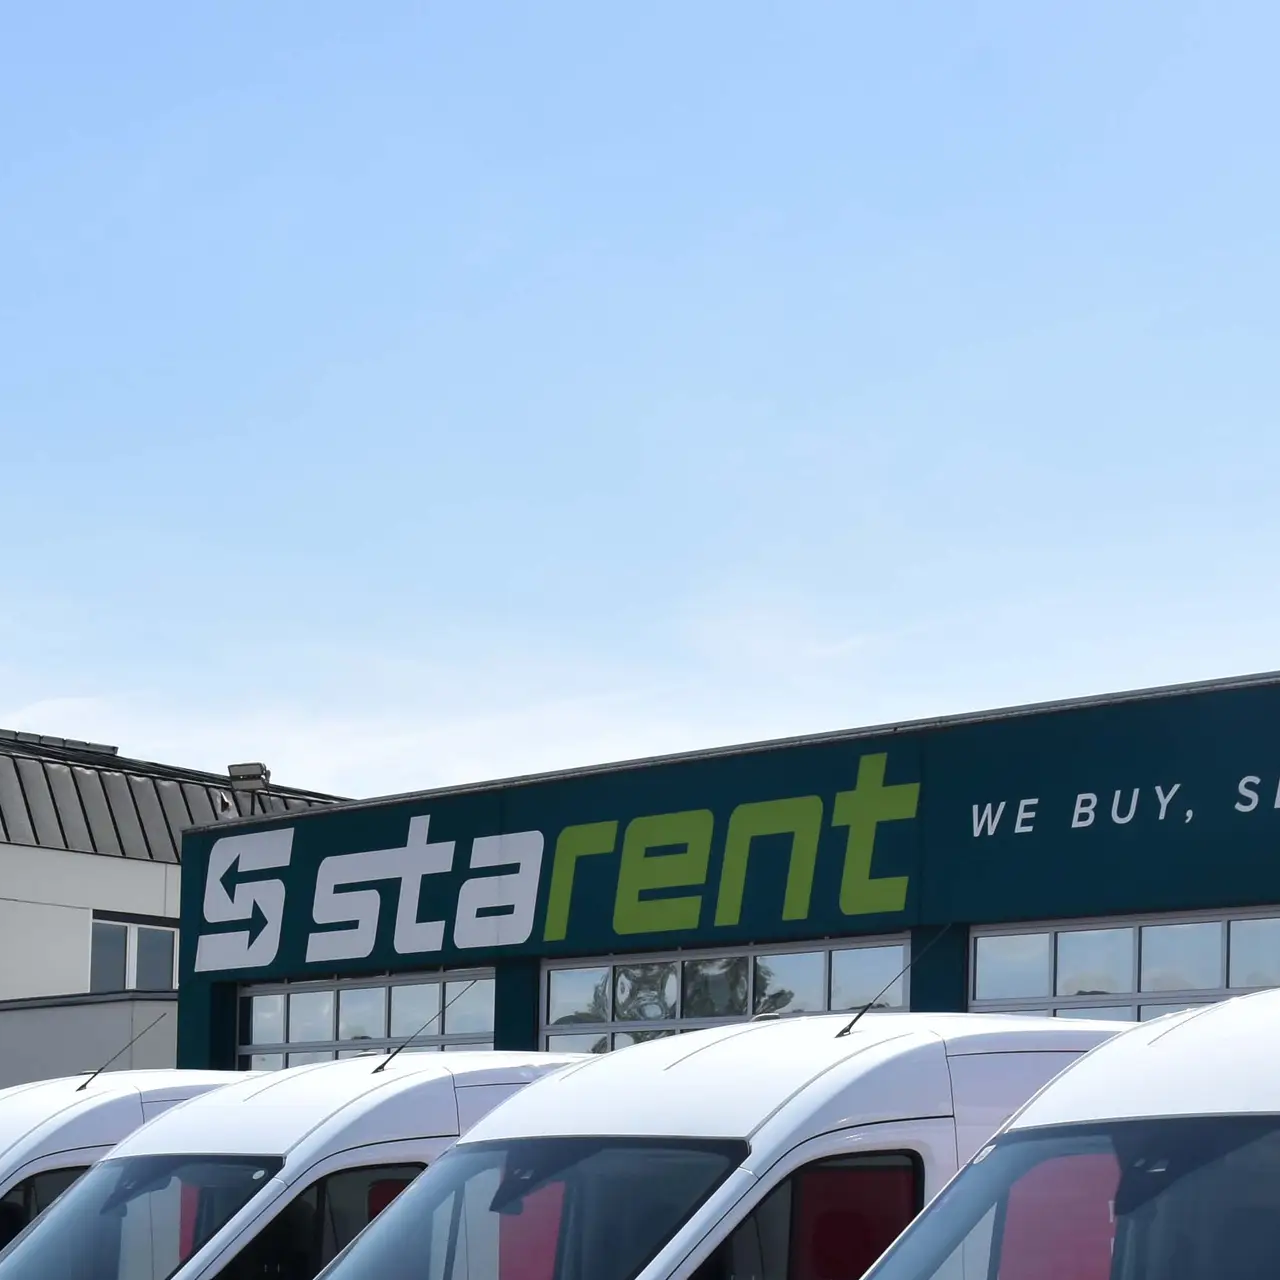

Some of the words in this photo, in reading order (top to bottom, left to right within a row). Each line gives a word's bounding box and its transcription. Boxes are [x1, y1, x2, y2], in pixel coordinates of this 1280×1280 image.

[306, 752, 921, 963] starent
[971, 797, 1039, 837] WE
[1071, 783, 1194, 828] BUY,
